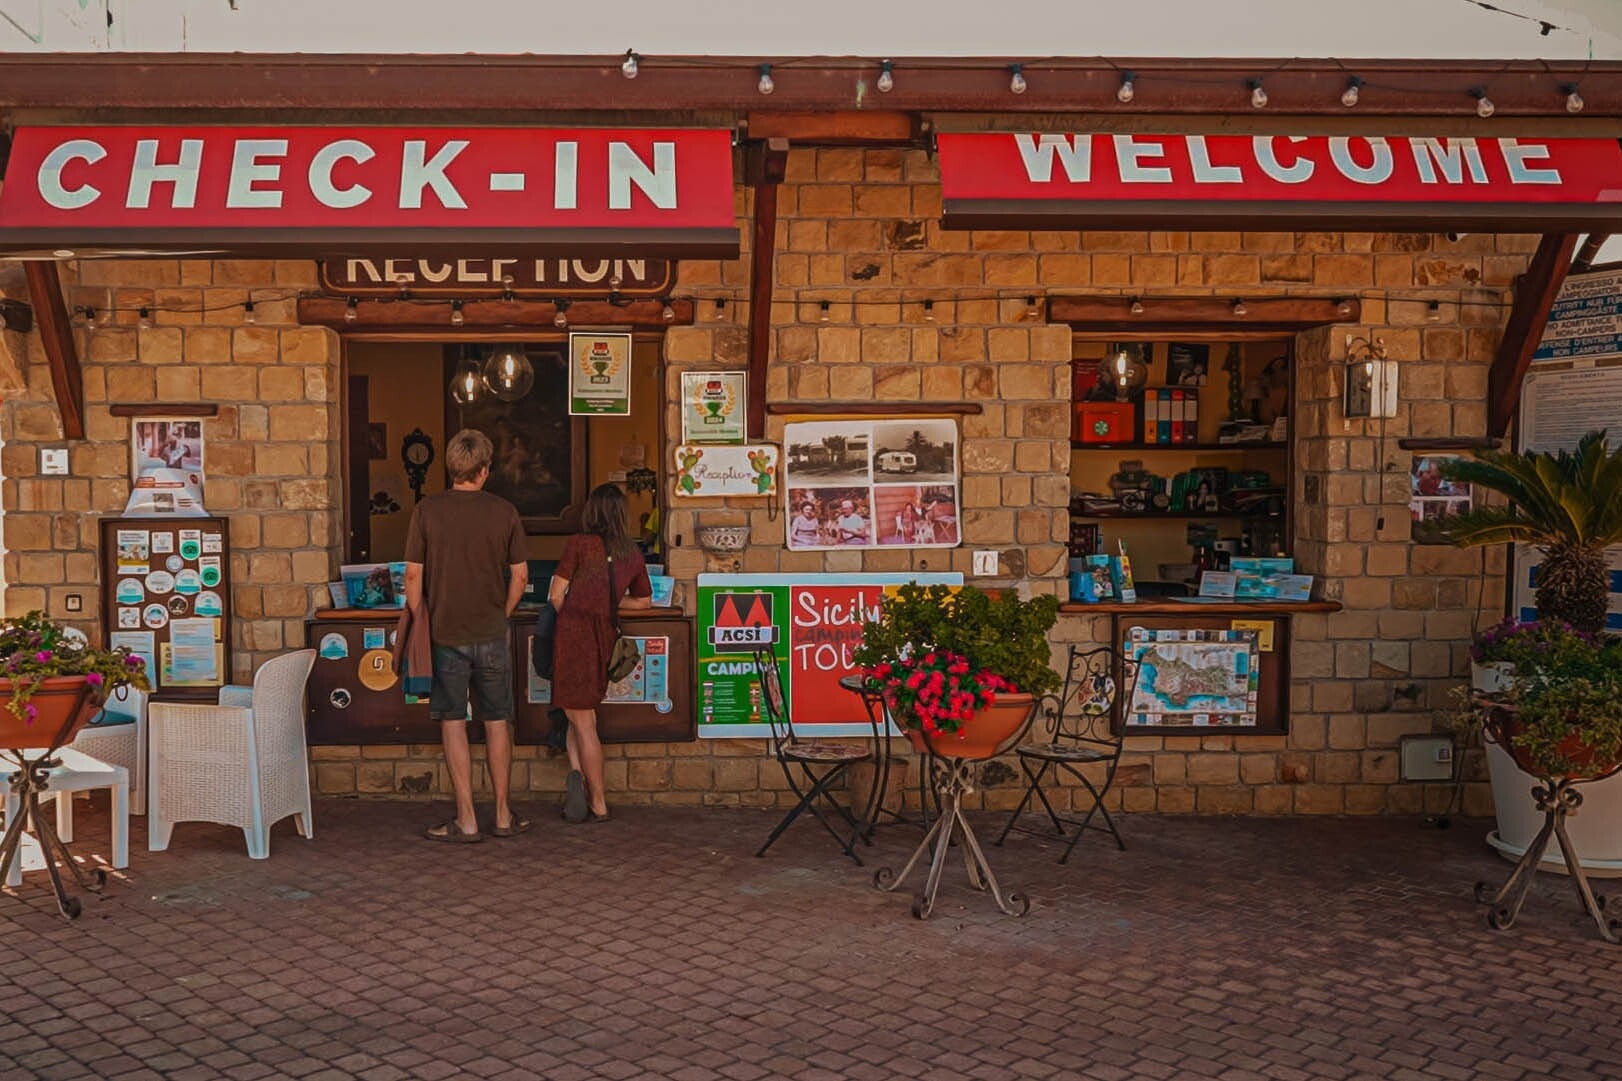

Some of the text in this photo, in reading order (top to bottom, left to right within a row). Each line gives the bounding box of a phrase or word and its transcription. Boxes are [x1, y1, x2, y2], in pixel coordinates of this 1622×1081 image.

[1014, 133, 1562, 185] WELCOME
[37, 139, 678, 210] CHECK-IN
[694, 463, 753, 487] Reception
[721, 629, 761, 641] ACSI
[707, 662, 781, 676] CAMPI
[794, 643, 860, 671] TOU
